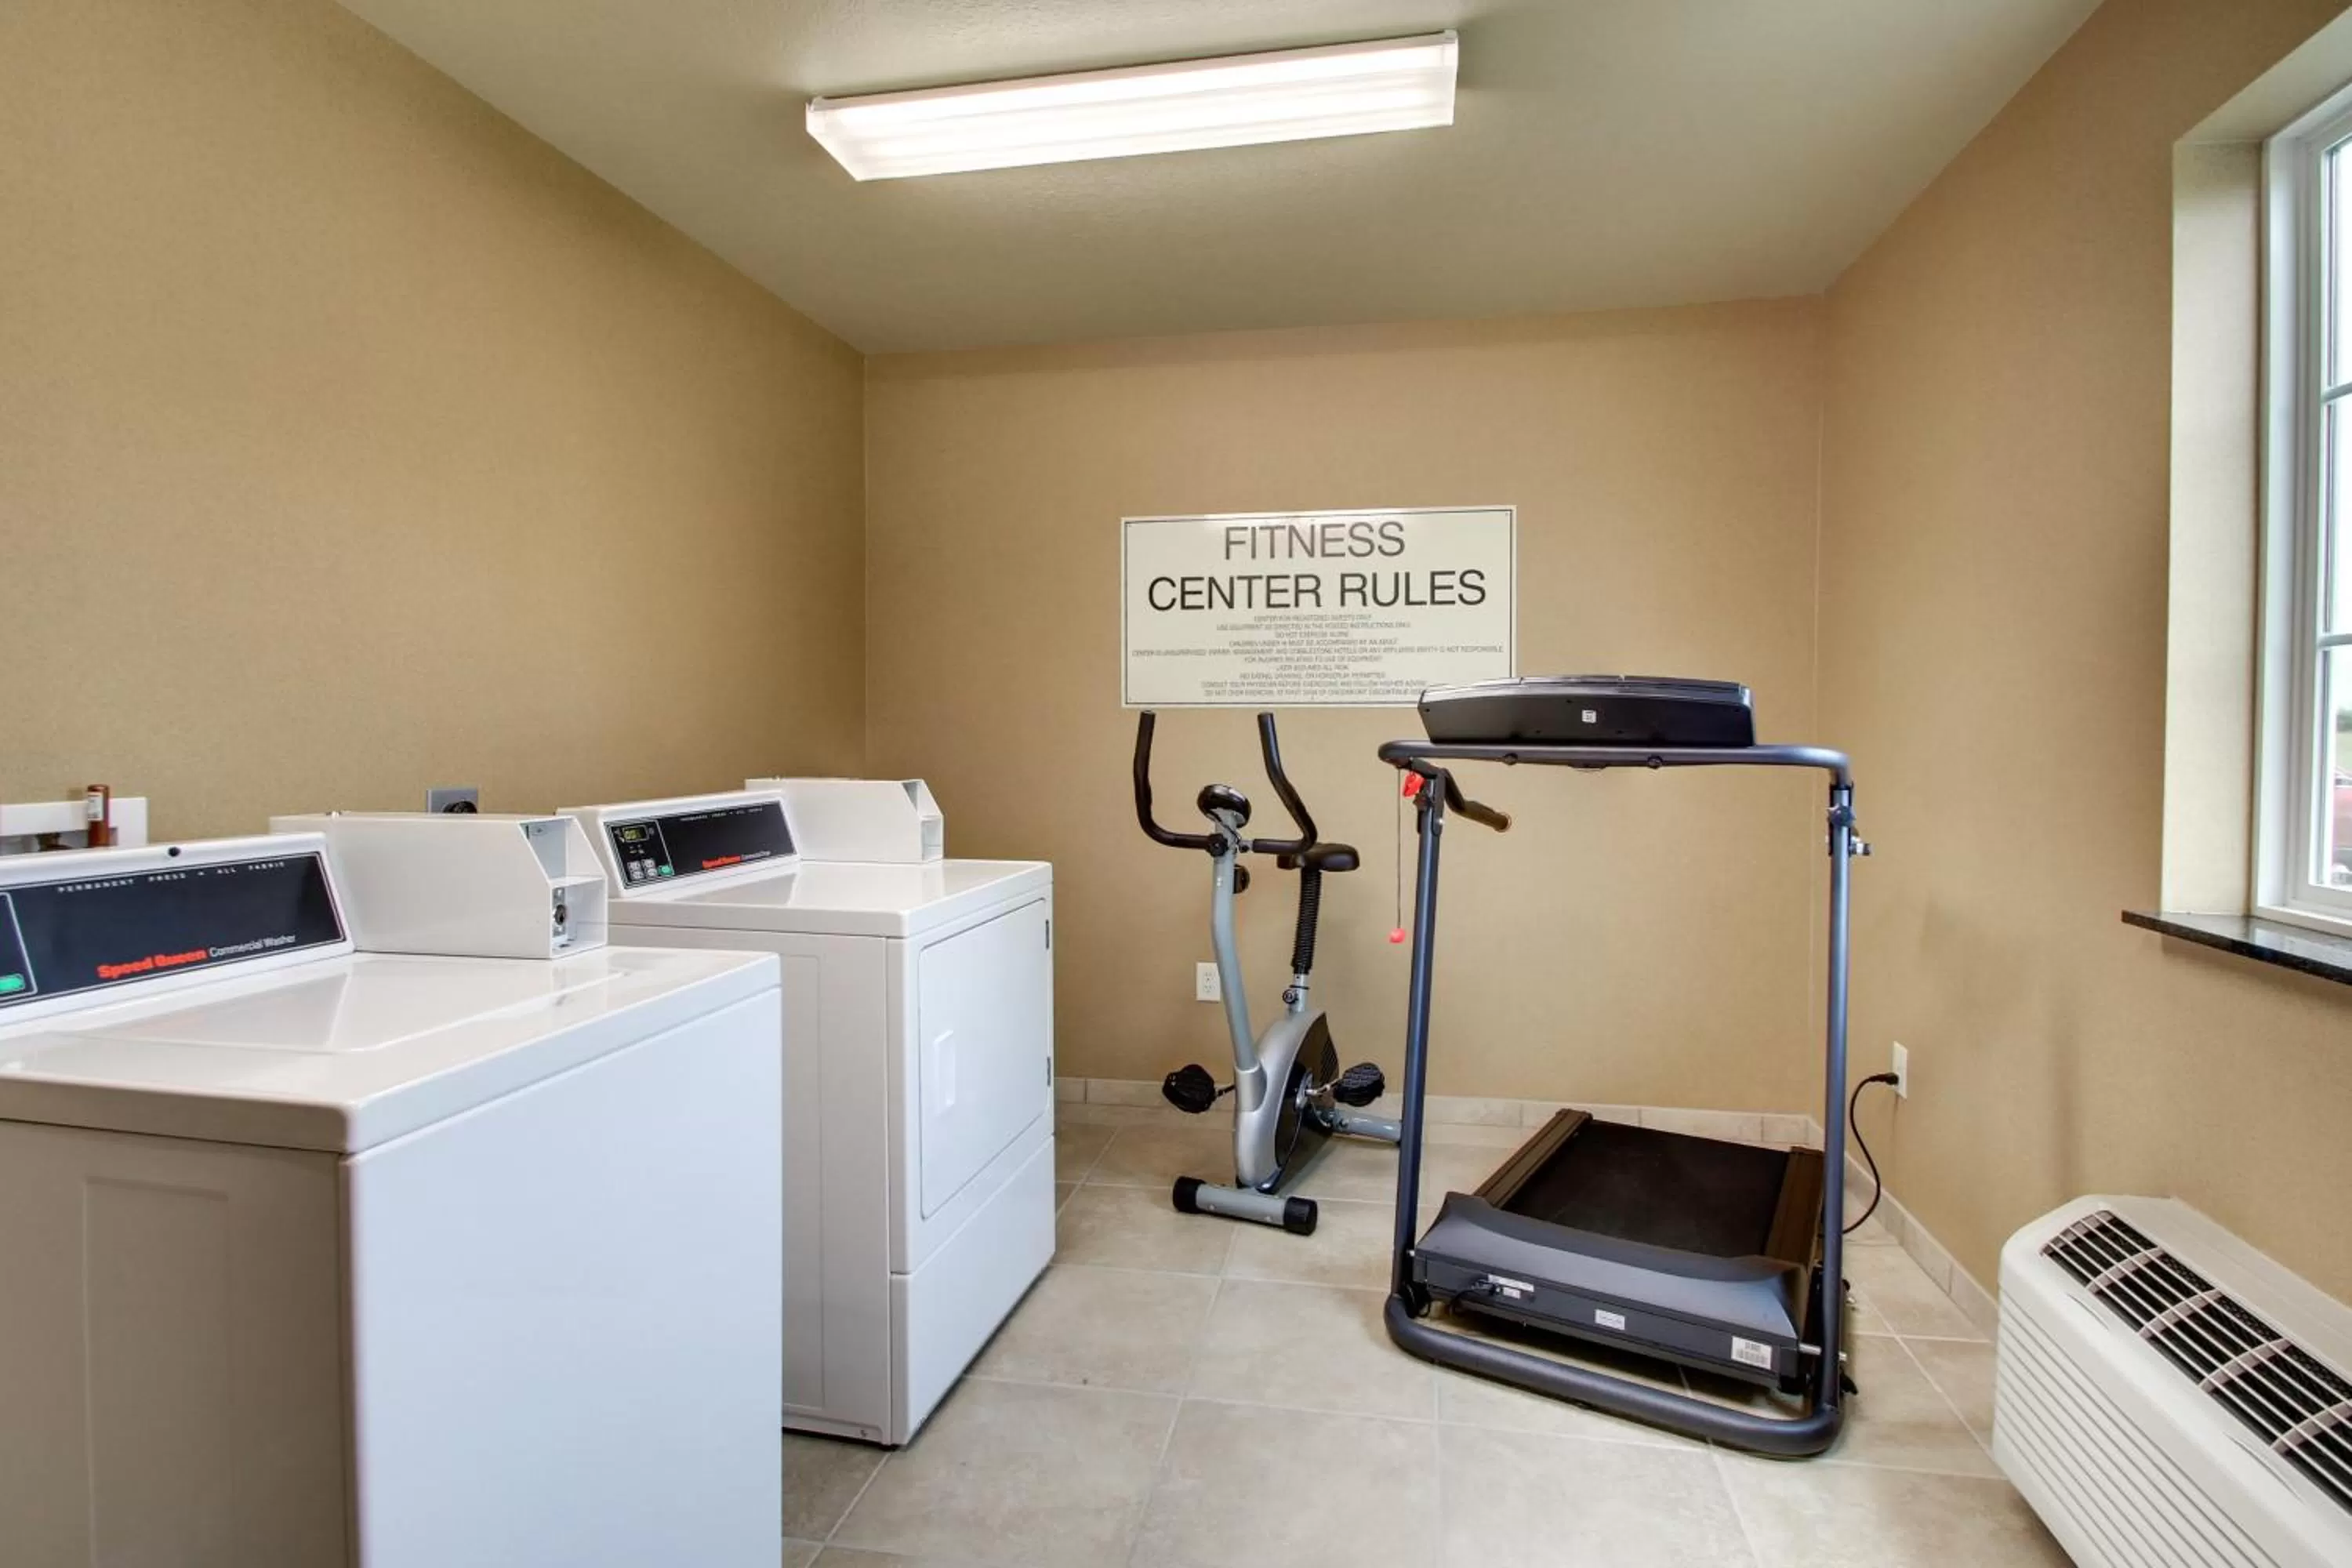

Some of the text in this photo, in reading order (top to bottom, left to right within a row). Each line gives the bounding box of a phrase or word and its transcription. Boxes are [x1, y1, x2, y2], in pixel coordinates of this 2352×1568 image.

[1225, 521, 1405, 560] FITNESS
[1148, 569, 1486, 612] CENTER RULES
[96, 934, 296, 980] Speed Queen Commercial Washer
